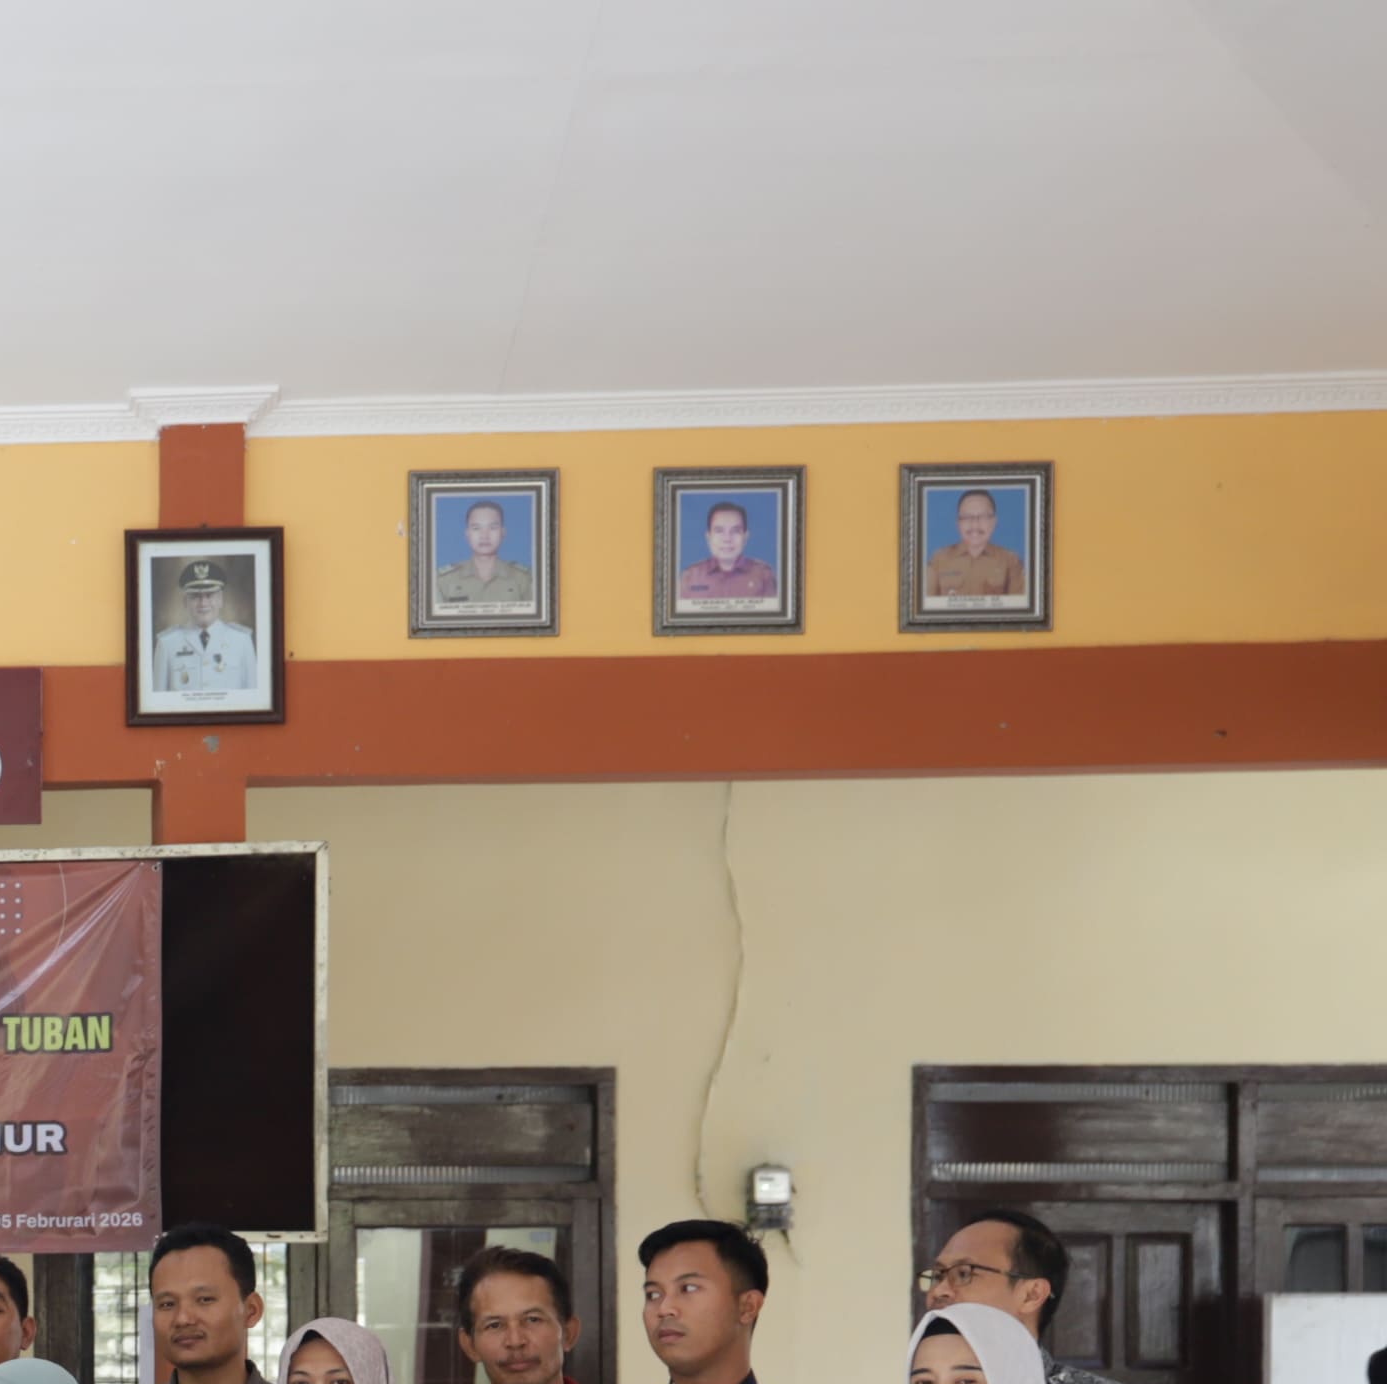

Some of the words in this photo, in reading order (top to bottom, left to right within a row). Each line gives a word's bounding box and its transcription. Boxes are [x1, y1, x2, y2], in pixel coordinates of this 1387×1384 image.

[2, 1013, 113, 1053] TUBAN
[16, 1212, 96, 1229] Februrari
[99, 1211, 143, 1228] 2026
